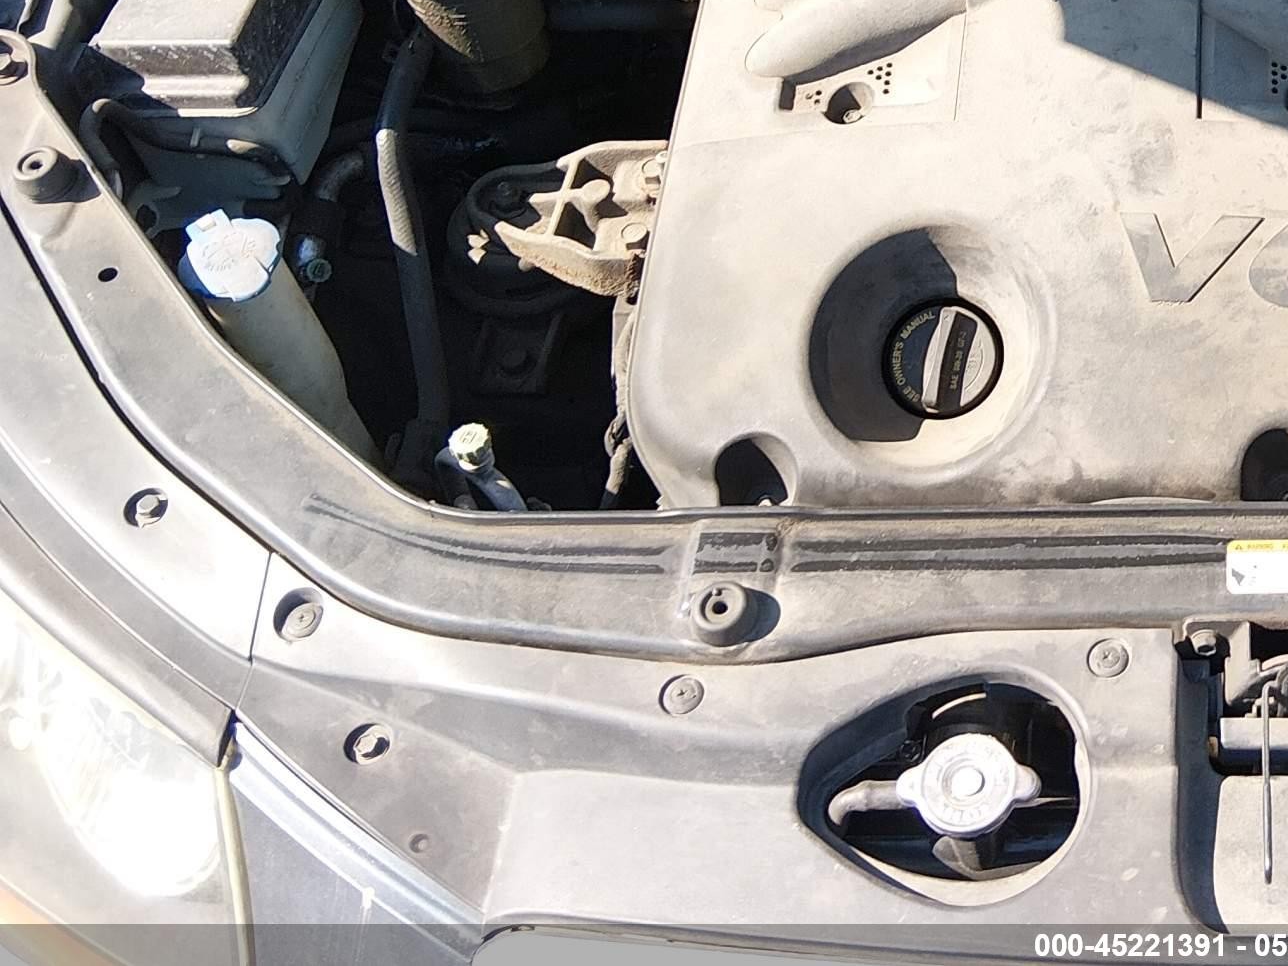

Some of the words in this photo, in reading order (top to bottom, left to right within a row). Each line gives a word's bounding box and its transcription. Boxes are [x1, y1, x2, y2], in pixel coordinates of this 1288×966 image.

[900, 310, 936, 340] MANUAL
[892, 341, 905, 386] OWNER'S
[902, 385, 920, 402] SEE
